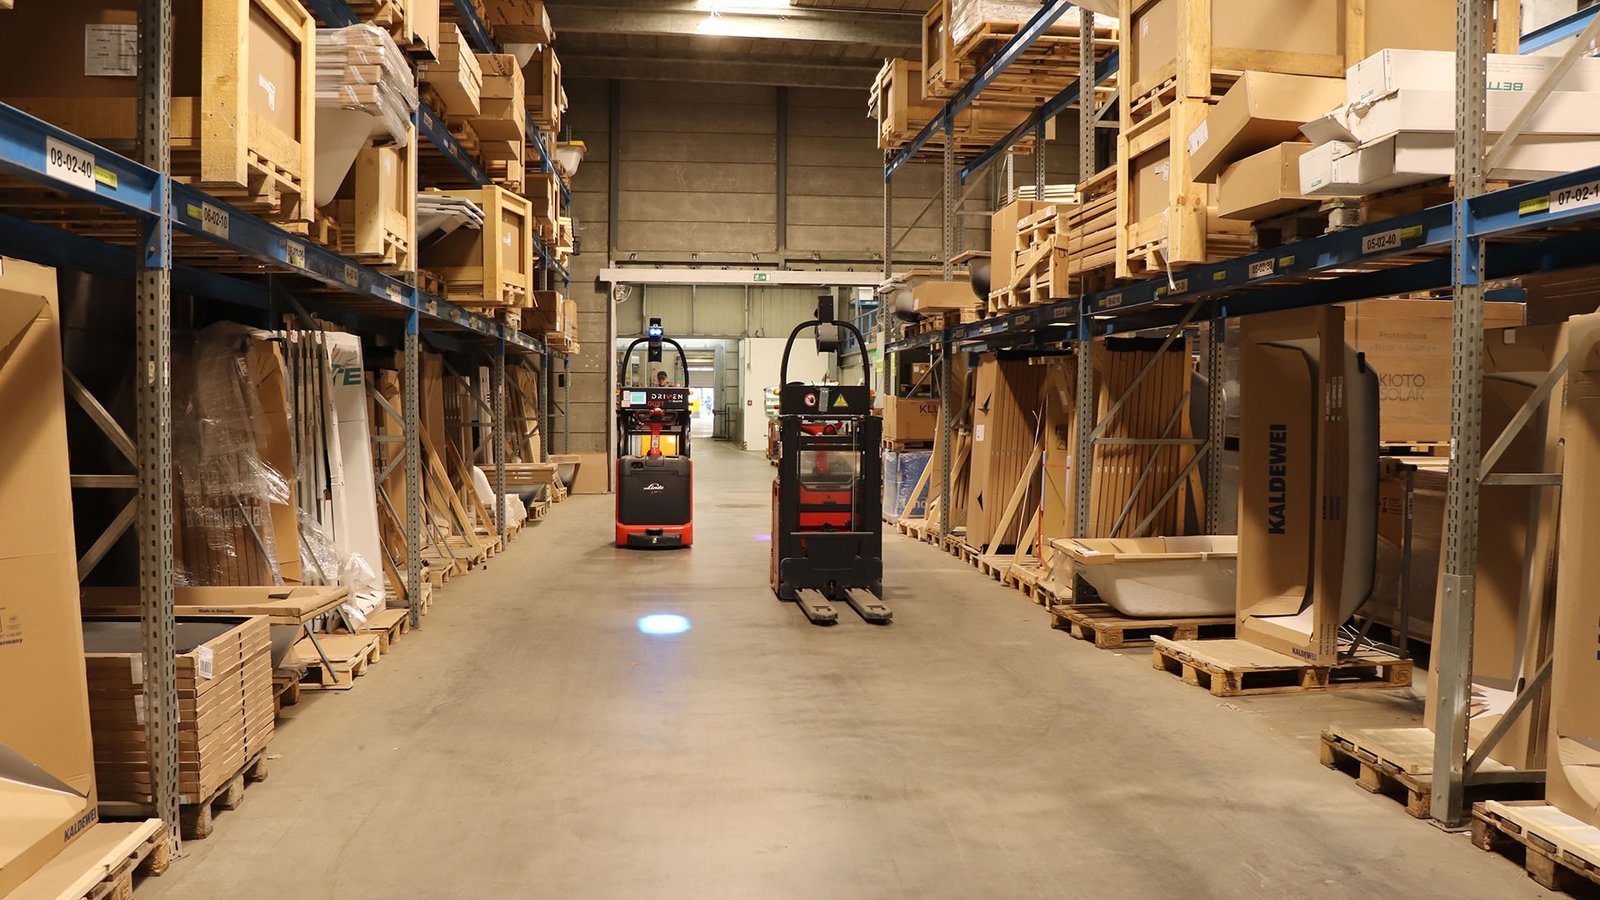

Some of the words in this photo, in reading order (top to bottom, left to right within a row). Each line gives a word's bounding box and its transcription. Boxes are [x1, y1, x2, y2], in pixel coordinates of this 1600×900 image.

[51, 147, 92, 178] 08-02-40
[203, 207, 228, 229] 06-02-10
[1367, 233, 1396, 250] 05-02-40
[1380, 373, 1426, 388] KIOTO
[1380, 387, 1425, 402] SOLAR
[1268, 424, 1287, 535] KALDEWEI
[1292, 646, 1317, 661] KALDEWEI
[64, 806, 97, 843] KALDEWEI
